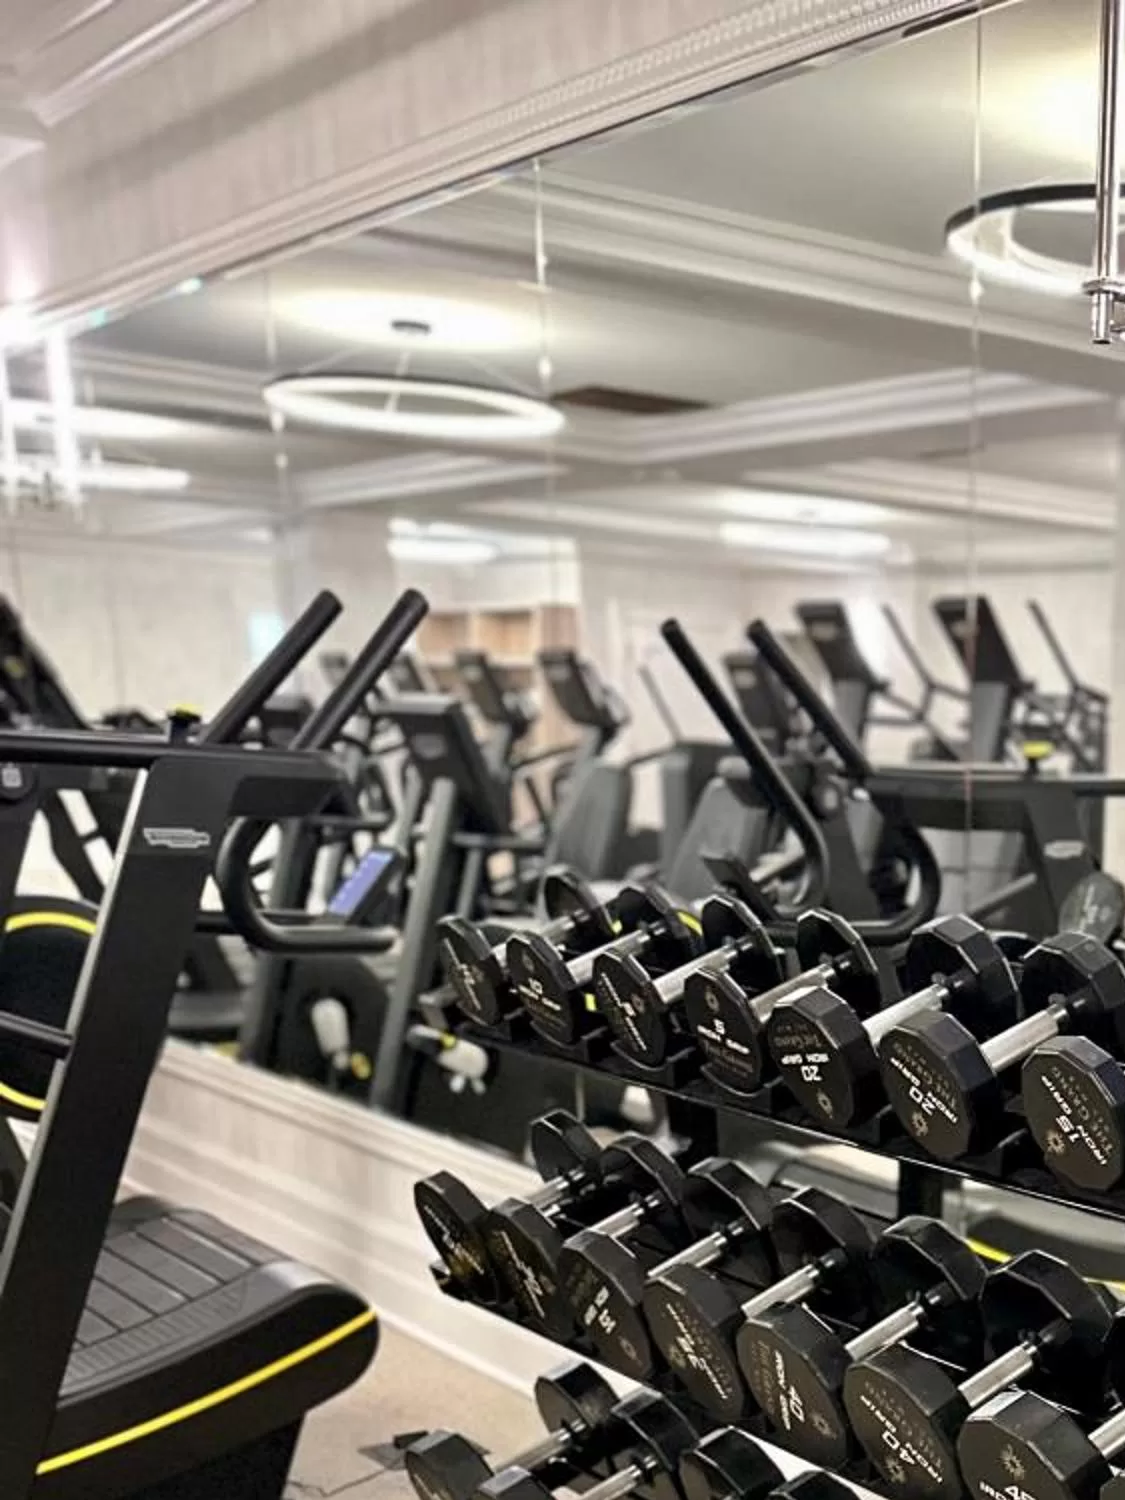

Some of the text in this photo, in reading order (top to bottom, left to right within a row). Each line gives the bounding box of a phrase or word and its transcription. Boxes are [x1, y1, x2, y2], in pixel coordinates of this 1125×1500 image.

[801, 1065, 823, 1083] 20
[889, 1056, 921, 1087] GRIP
[908, 1085, 936, 1117] 20
[926, 1090, 959, 1124] IRON
[1040, 1074, 1108, 1166] IRON GRIP
[1056, 1113, 1081, 1144] 15
[787, 1384, 806, 1424] 40
[859, 1394, 897, 1434] GRIP
[881, 1430, 917, 1465] 40
[904, 1441, 944, 1484] IRON
